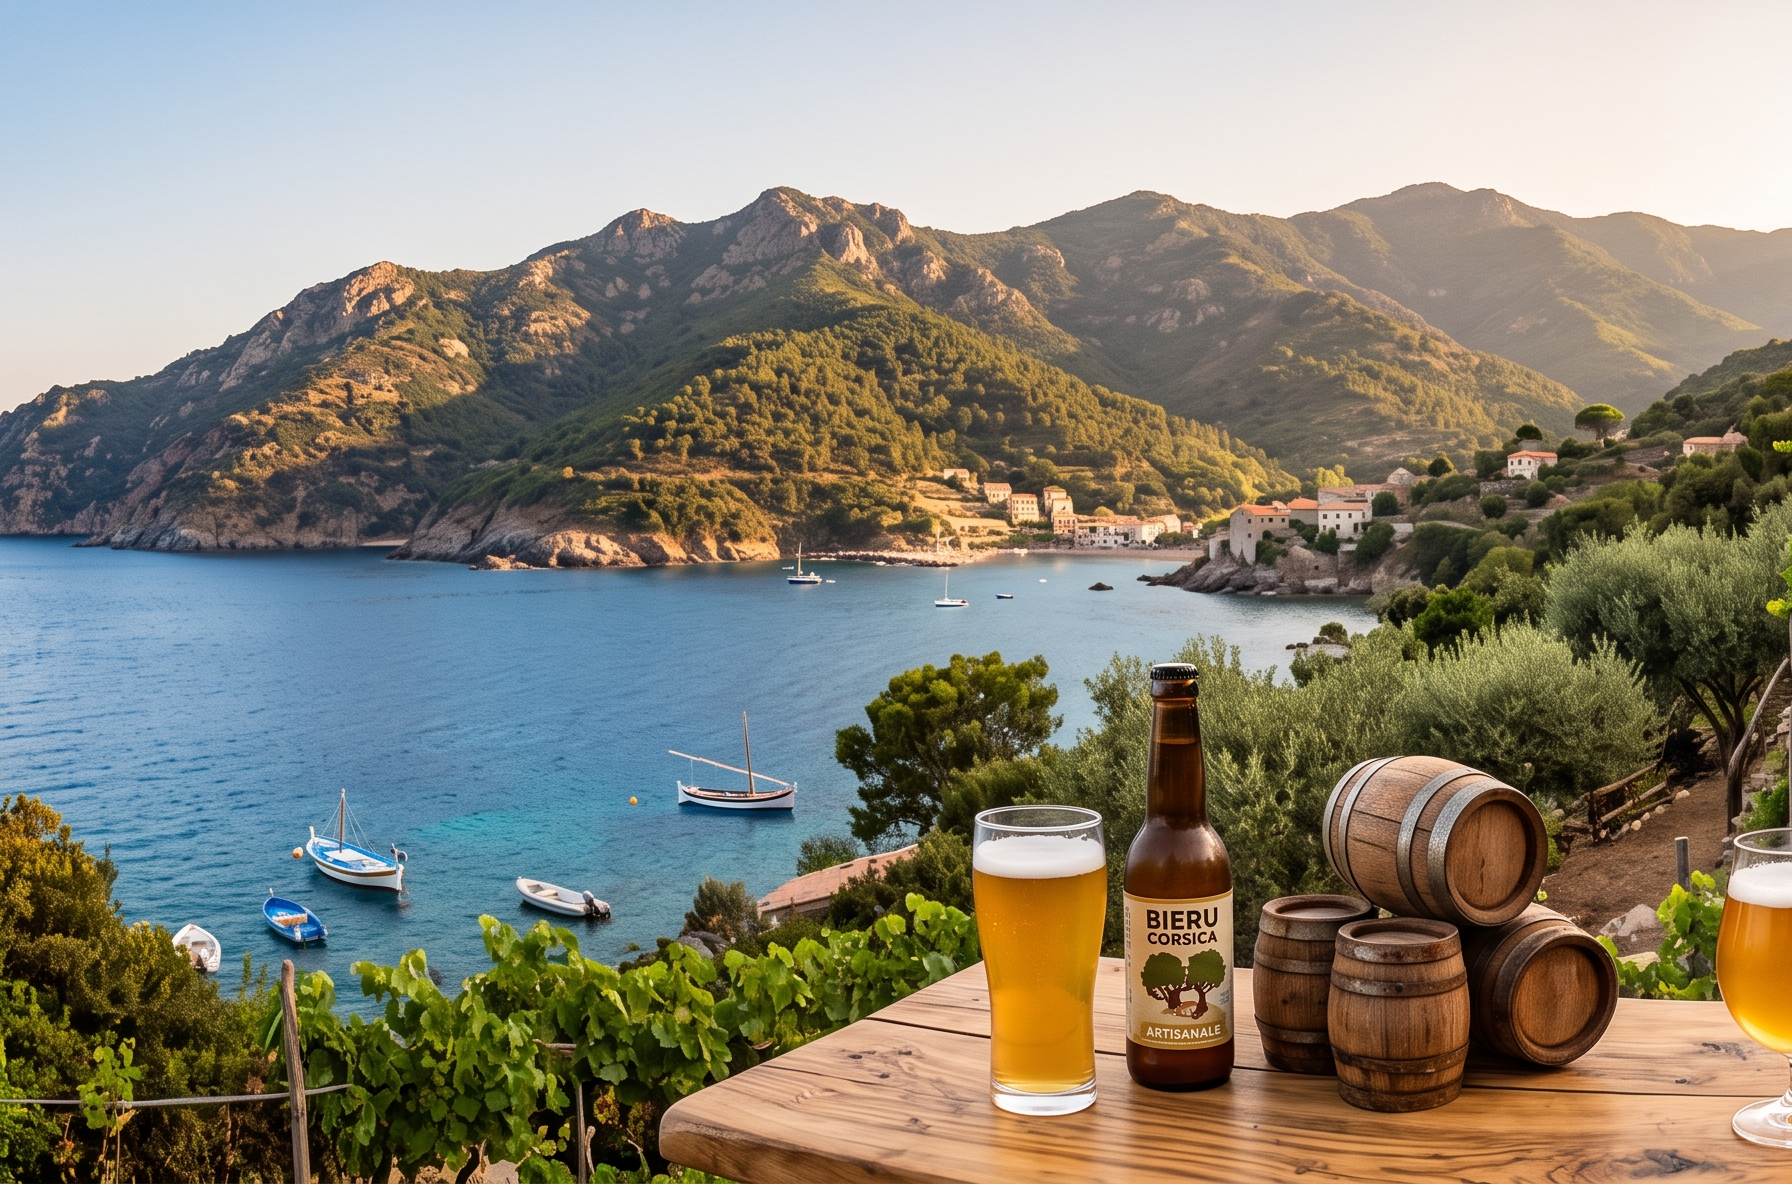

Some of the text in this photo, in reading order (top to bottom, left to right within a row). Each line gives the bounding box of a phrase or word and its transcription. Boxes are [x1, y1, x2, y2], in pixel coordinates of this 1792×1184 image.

[1146, 907, 1218, 931] BIERU
[1147, 930, 1218, 945] CORSICA
[1146, 1024, 1221, 1040] ARTISANALE
